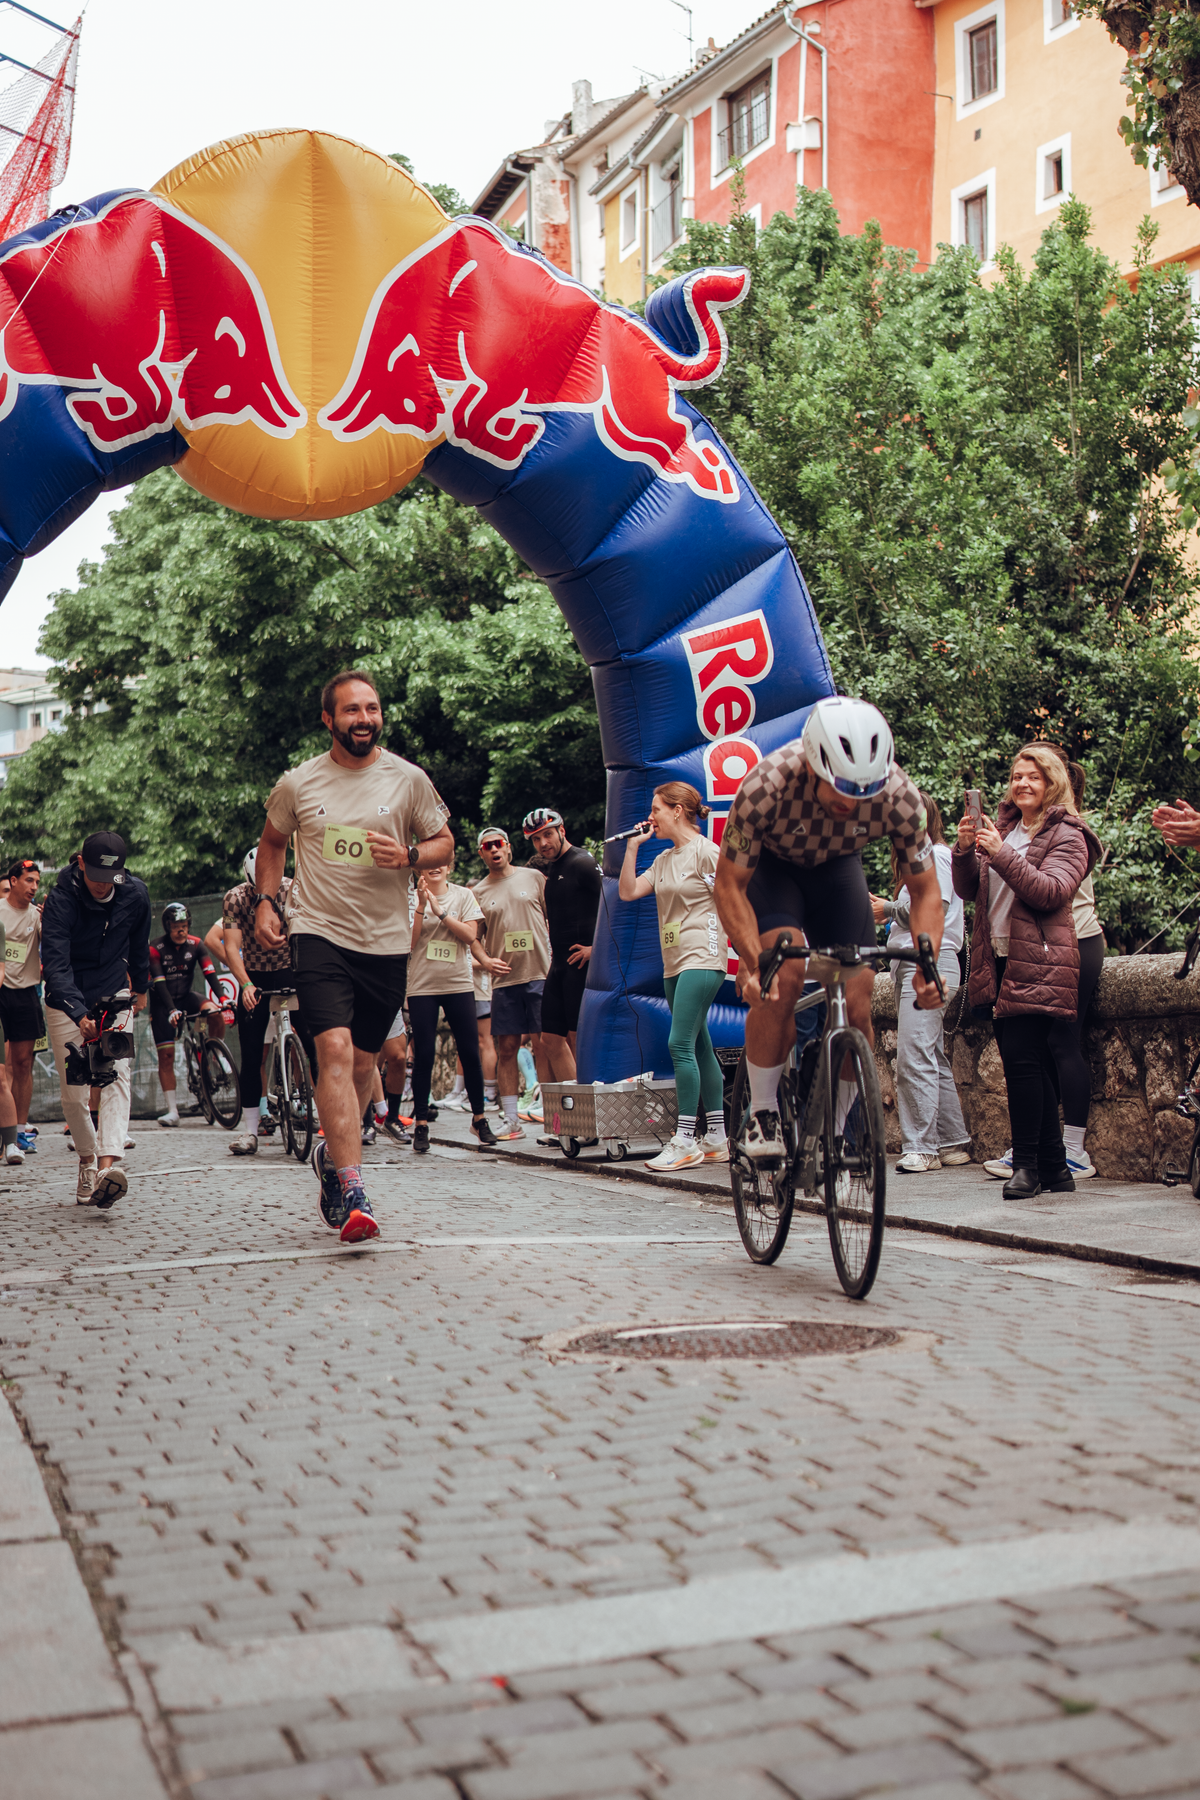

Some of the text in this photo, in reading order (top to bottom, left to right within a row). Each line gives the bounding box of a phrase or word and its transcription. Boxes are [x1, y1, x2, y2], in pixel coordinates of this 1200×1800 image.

[334, 838, 364, 859] 60
[664, 931, 675, 944] 69
[706, 912, 719, 957] FOURIER
[511, 938, 527, 949] 66
[5, 948, 19, 959] 65
[433, 947, 451, 959] 119
[833, 971, 841, 982] 1
[280, 1000, 288, 1008] 2
[36, 1039, 45, 1048] 96
